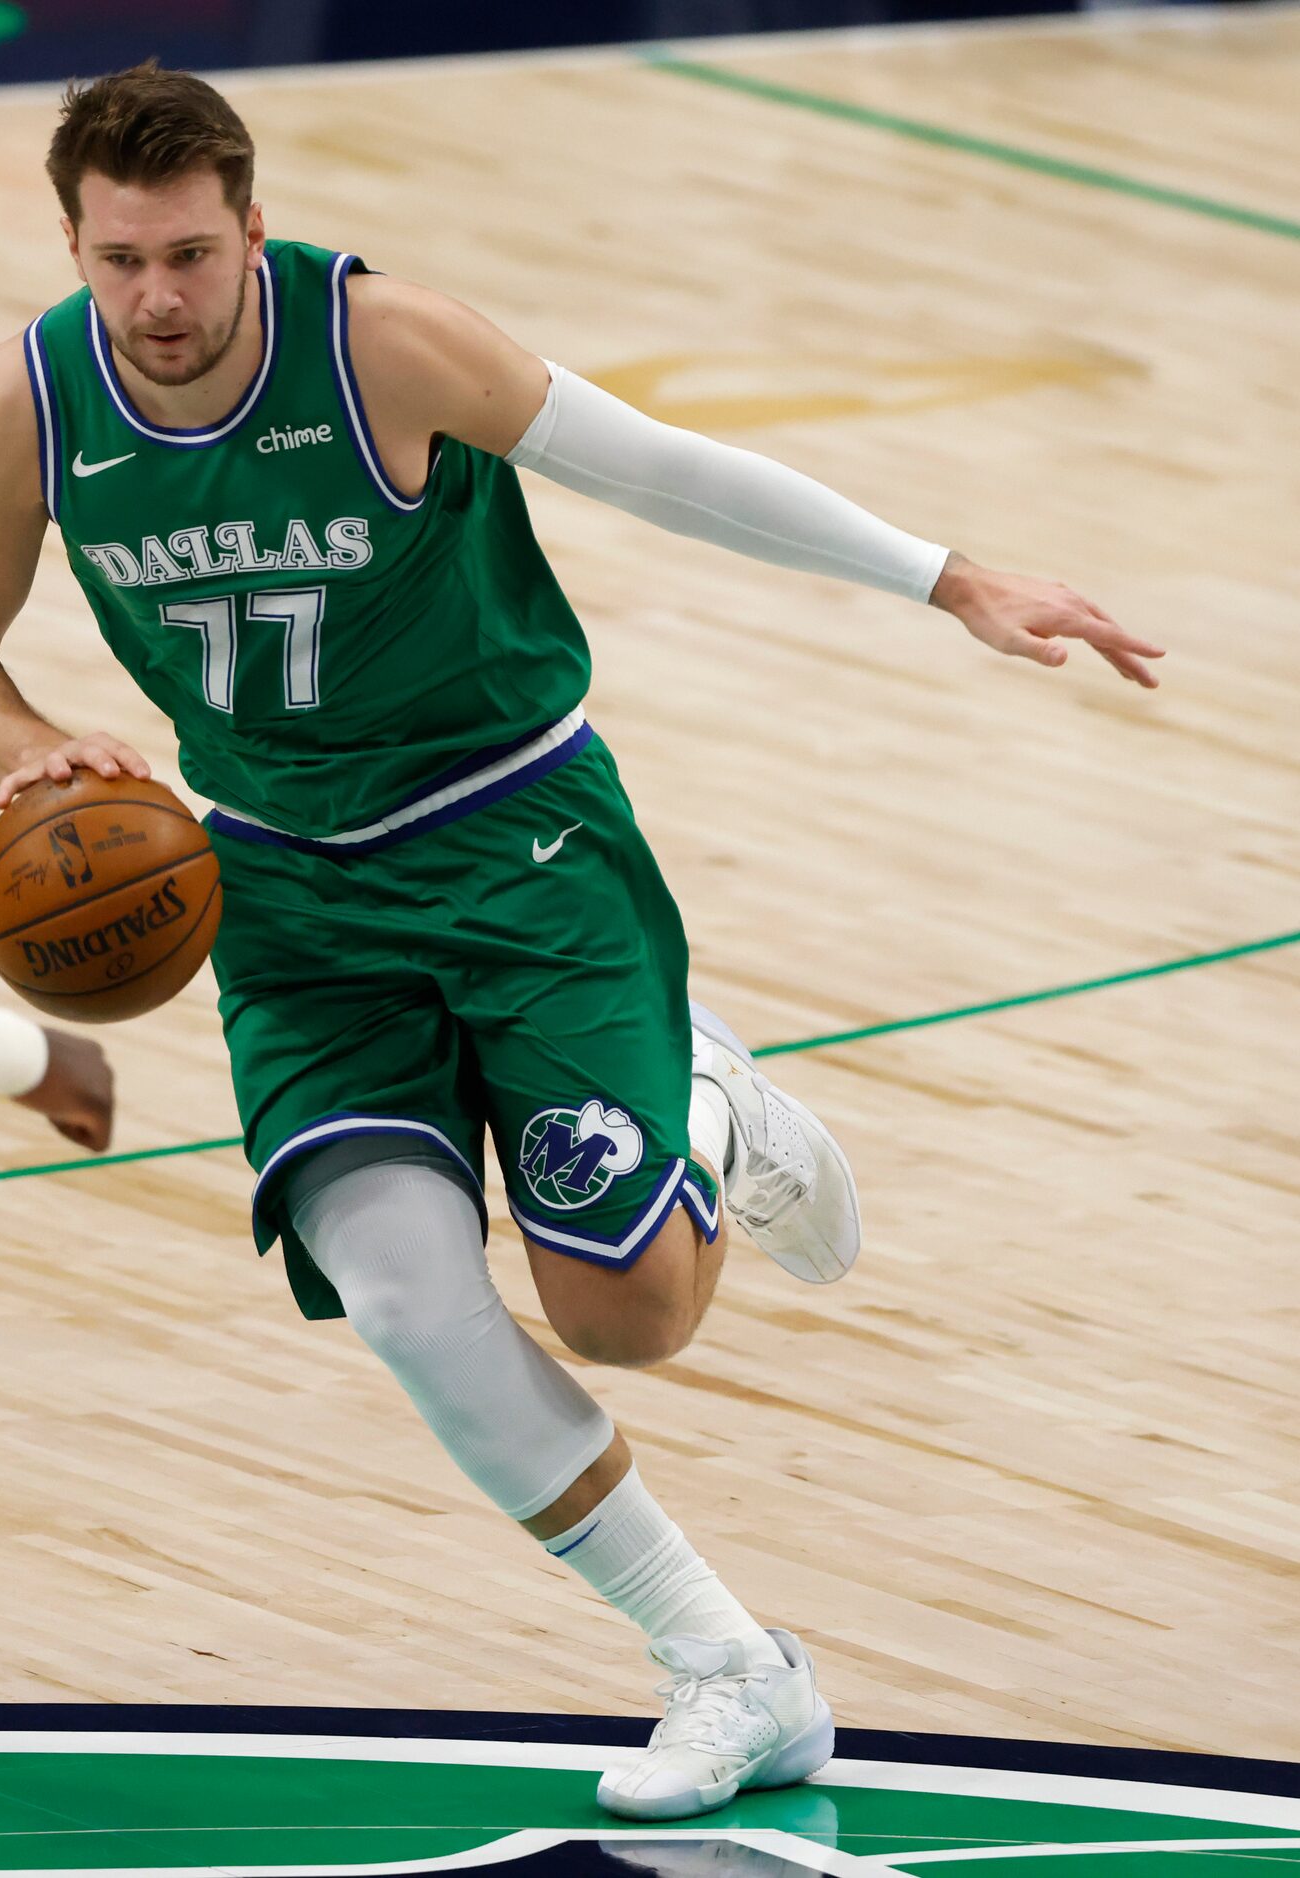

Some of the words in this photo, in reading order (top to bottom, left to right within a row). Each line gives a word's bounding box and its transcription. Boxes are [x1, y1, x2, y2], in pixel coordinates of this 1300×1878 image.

[256, 423, 334, 454] chime
[80, 517, 374, 587] DALLAS
[158, 585, 327, 715] 77
[21, 875, 187, 978] SPALDING
